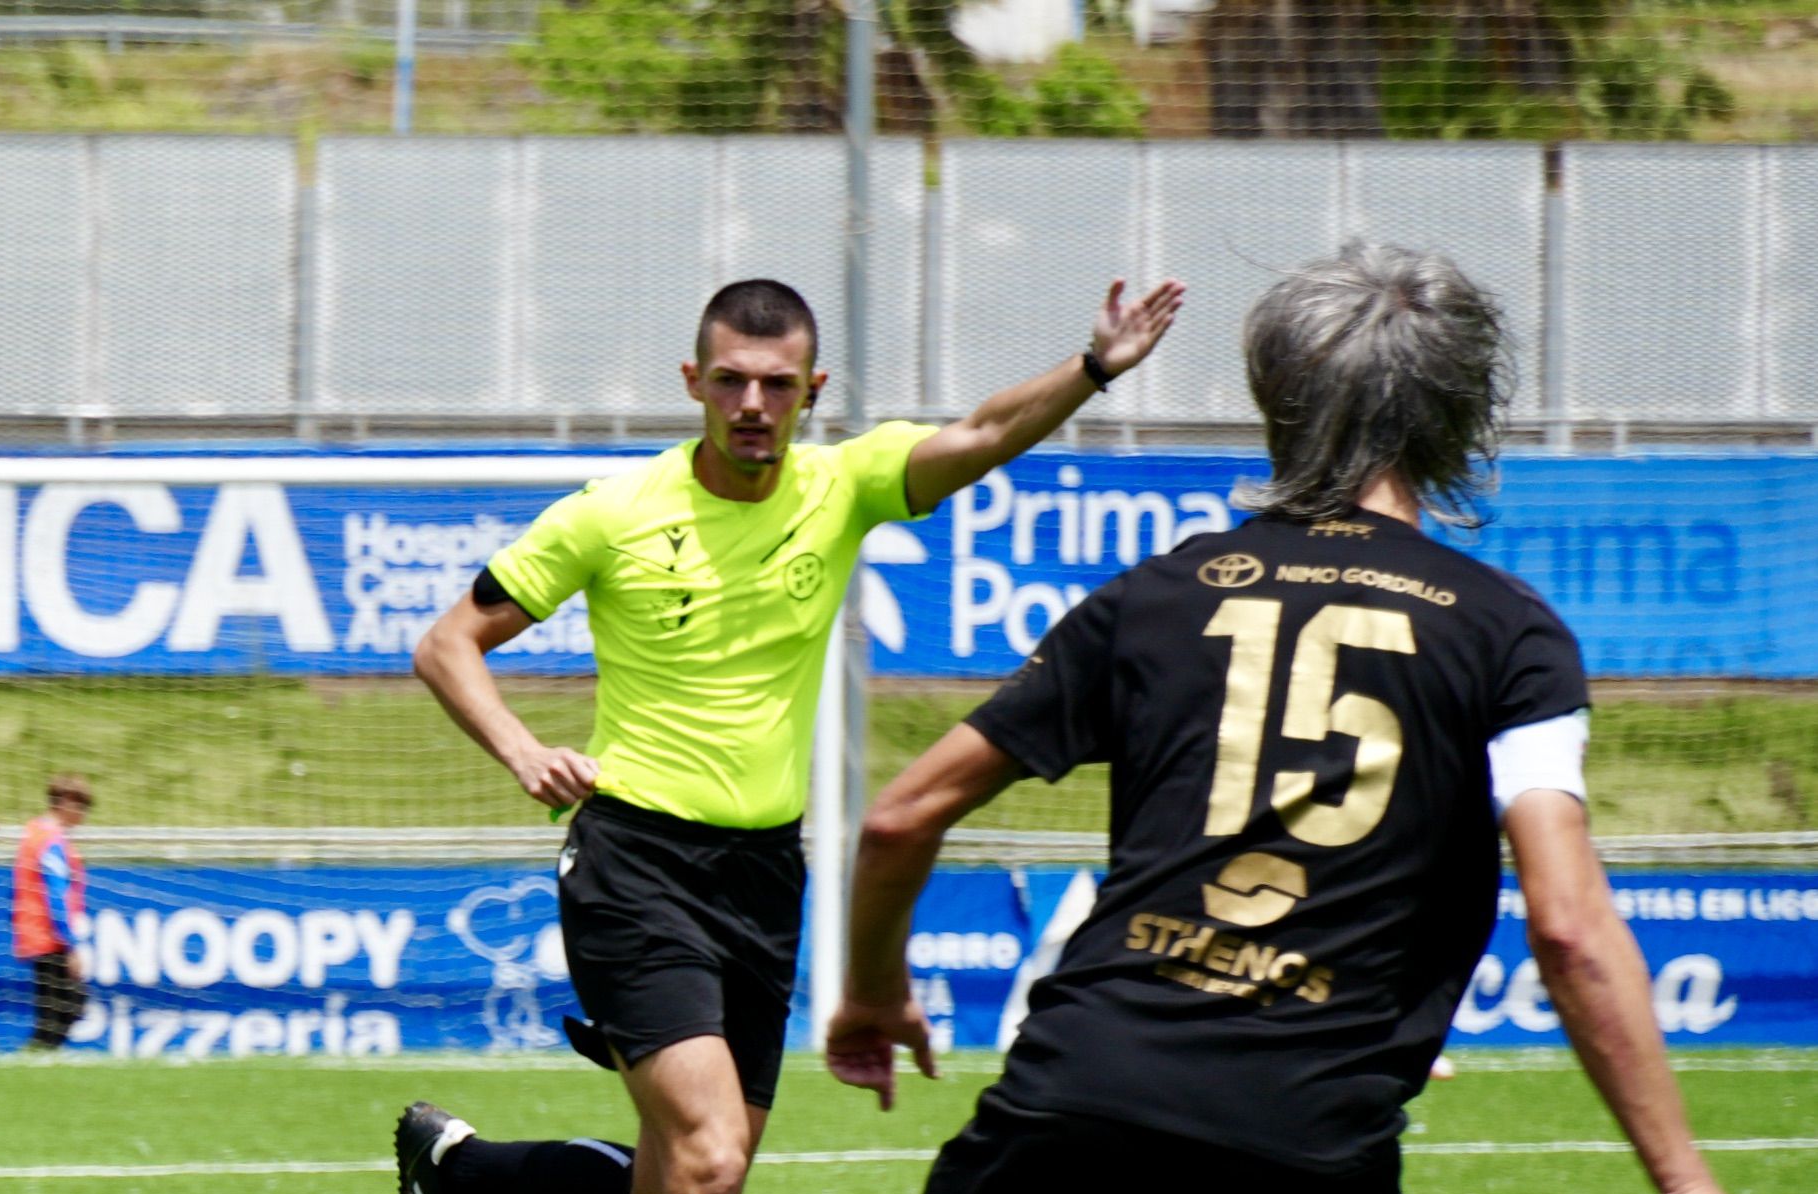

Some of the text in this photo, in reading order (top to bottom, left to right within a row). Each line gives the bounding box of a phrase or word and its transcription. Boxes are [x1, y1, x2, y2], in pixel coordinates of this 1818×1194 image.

[343, 512, 534, 575] Hospit
[950, 465, 1233, 567] Prima
[343, 560, 474, 607] Cent
[950, 556, 1090, 659] Po
[1275, 565, 1458, 607] NIMO GORDILLO
[1201, 597, 1418, 848] 15
[1700, 888, 1746, 921] EN
[905, 941, 1022, 971] ORRO
[1125, 912, 1334, 1004] STHENOS
